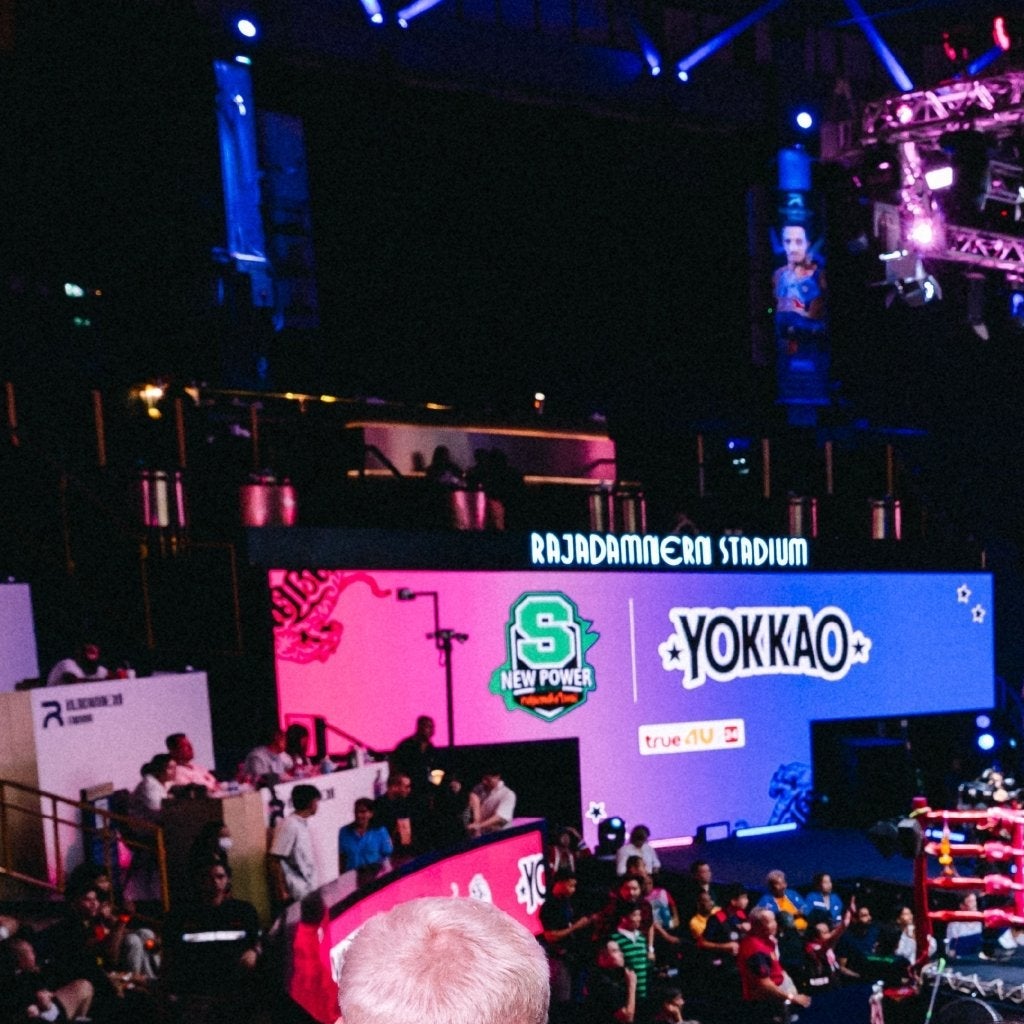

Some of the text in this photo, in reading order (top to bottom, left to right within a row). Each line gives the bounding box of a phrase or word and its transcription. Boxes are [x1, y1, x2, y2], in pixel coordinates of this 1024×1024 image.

[530, 532, 808, 567] RAJADAMNERN STADIUM
[515, 595, 576, 669] S
[678, 612, 849, 681] YOKKAO
[501, 666, 592, 691] NEW POWER
